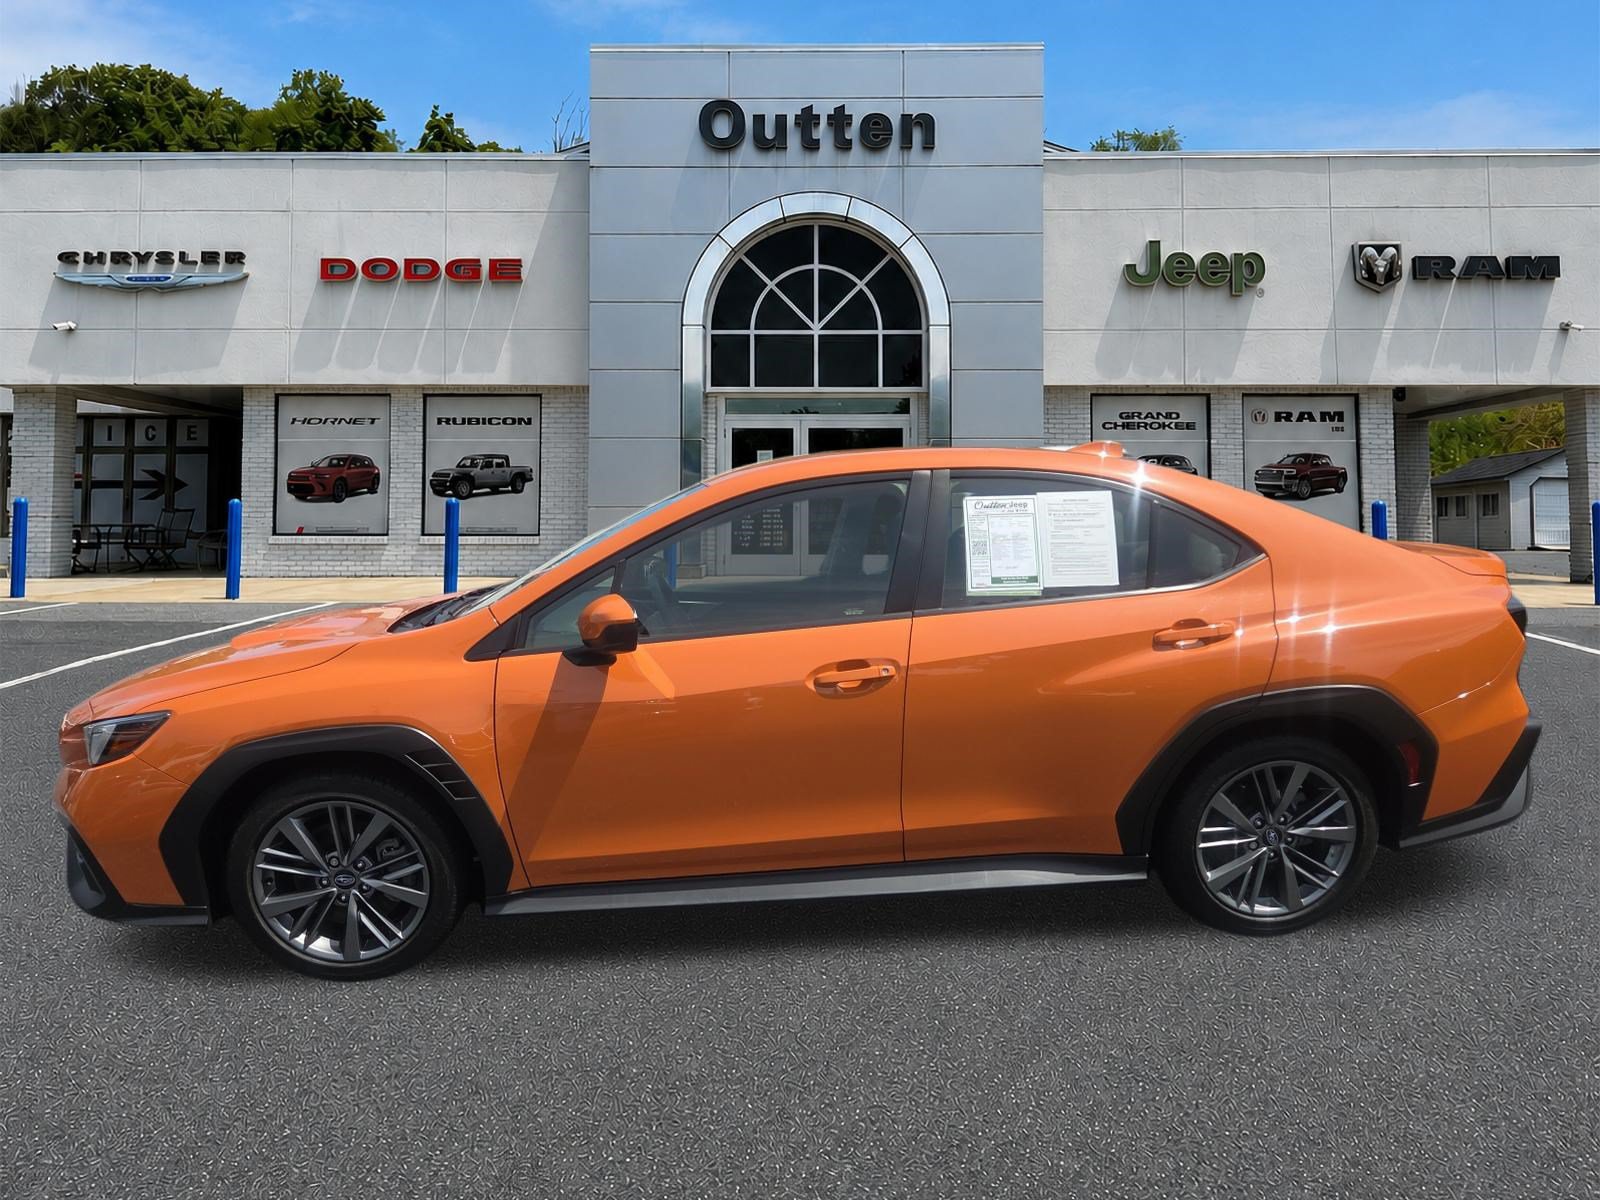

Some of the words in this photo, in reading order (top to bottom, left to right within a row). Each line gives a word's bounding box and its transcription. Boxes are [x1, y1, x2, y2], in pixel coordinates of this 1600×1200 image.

[699, 98, 936, 151] Outten
[57, 250, 247, 266] CHRYSLER
[320, 257, 523, 282] DODGE
[1123, 240, 1266, 297] Jeep
[1412, 255, 1561, 280] RAM
[289, 416, 381, 426] HORNET
[436, 416, 533, 426] RUBICON
[1118, 411, 1181, 421] GRAND
[1273, 411, 1345, 423] RAM
[1101, 421, 1197, 431] CHEROKEE
